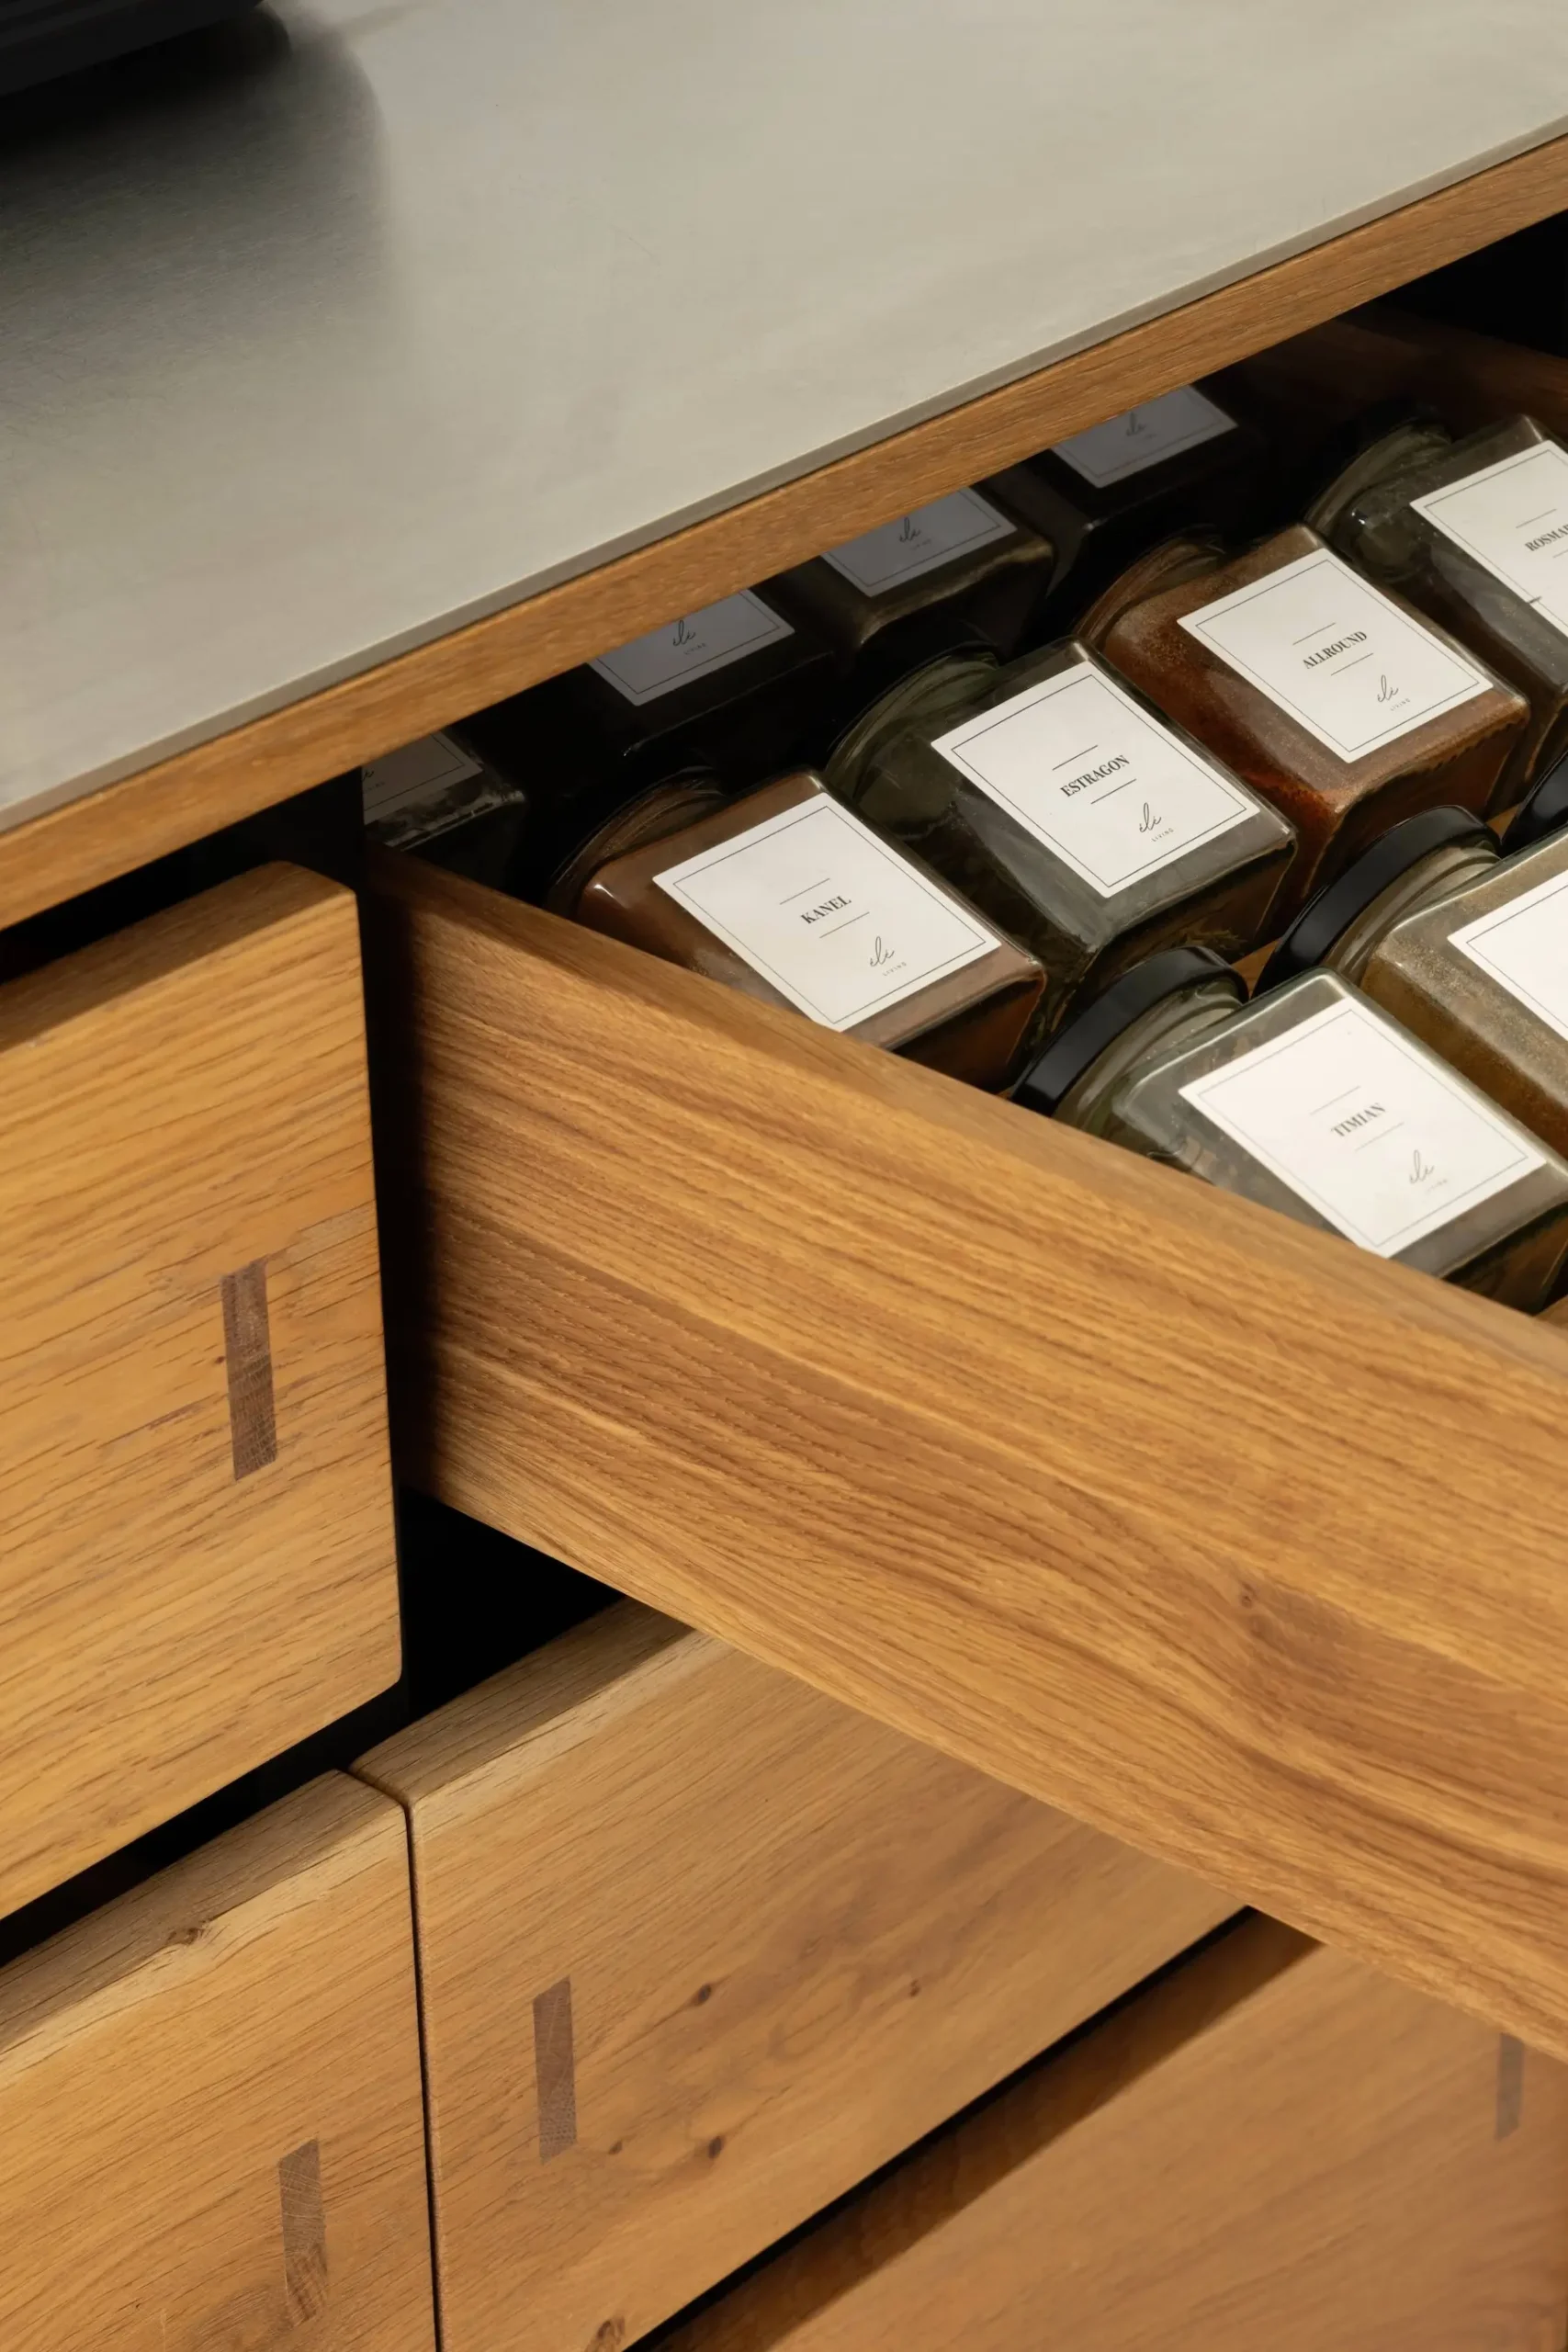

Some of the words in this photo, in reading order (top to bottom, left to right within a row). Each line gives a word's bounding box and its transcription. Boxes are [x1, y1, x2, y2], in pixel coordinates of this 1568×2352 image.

[1303, 631, 1368, 669] ALLROUND
[1059, 754, 1130, 797] ESTRAGON
[1151, 828, 1174, 842] LIVING
[799, 895, 852, 923] KANEL
[882, 962, 907, 976] LIVING
[1331, 1102, 1386, 1136] TIMIAN
